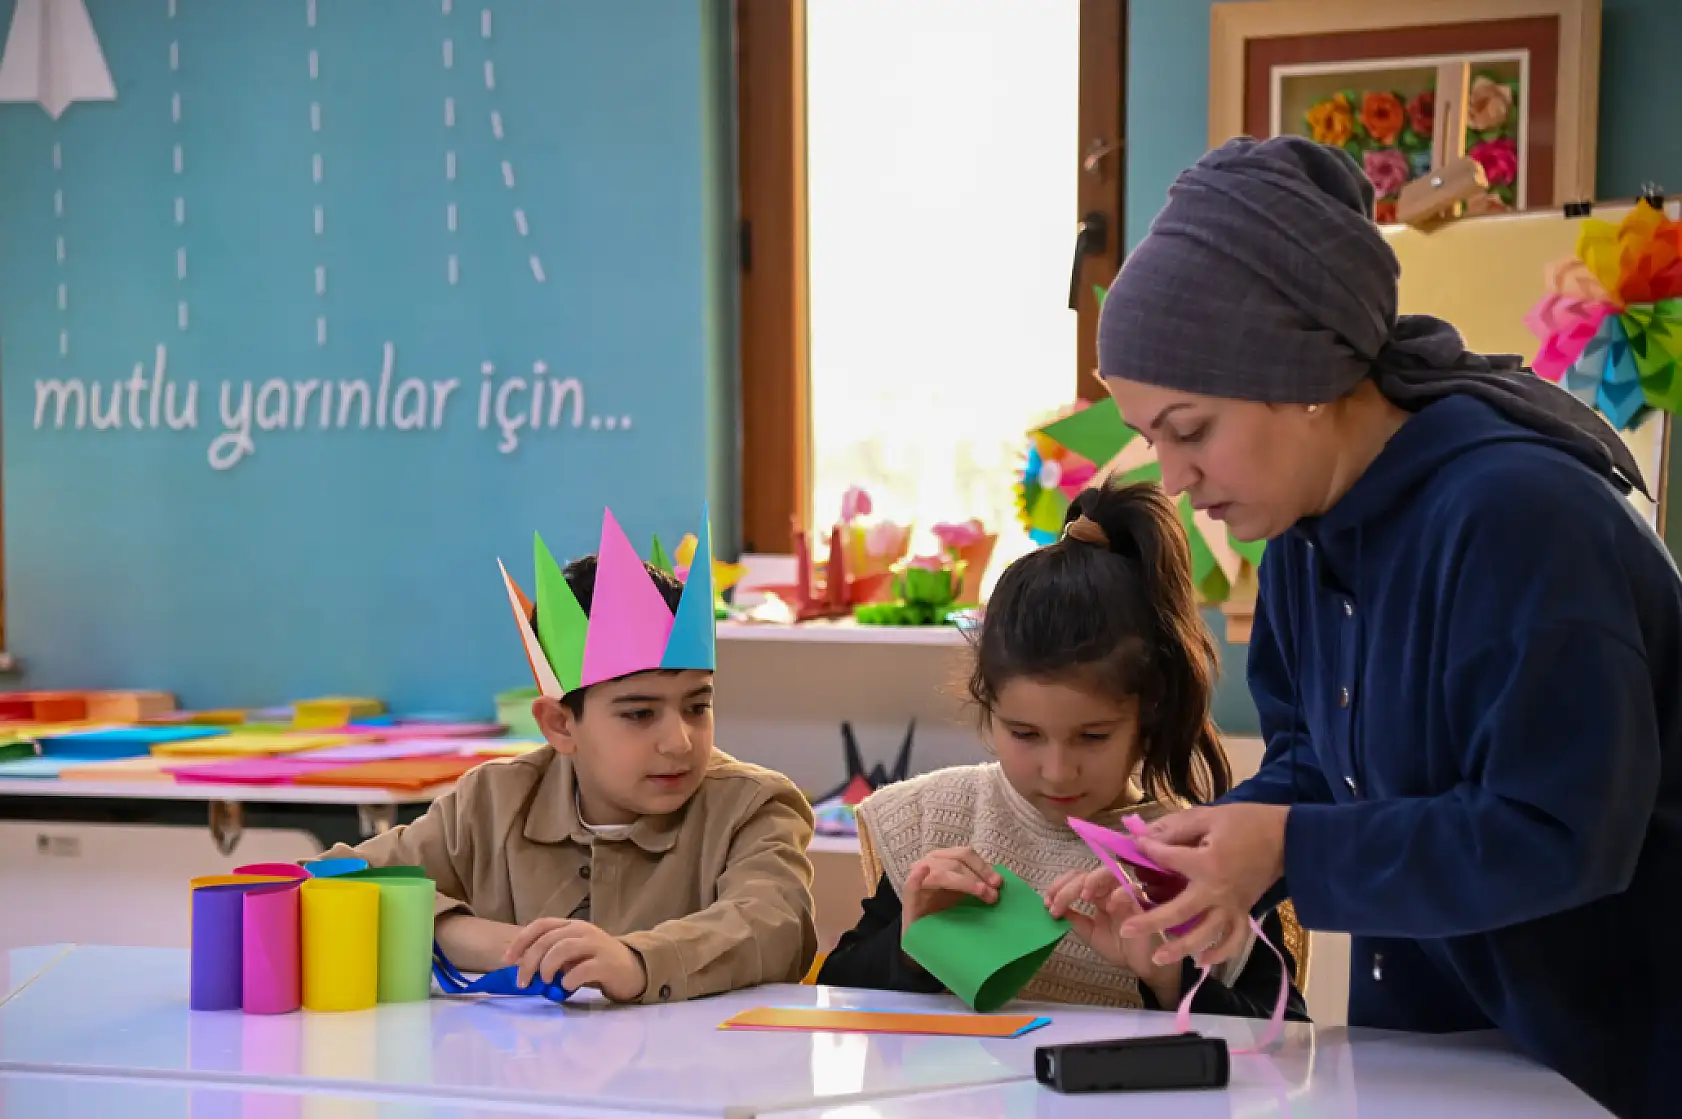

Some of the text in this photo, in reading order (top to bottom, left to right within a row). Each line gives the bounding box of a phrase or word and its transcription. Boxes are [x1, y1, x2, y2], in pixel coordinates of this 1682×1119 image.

[33, 342, 633, 471] mutlu yarınlar için...
